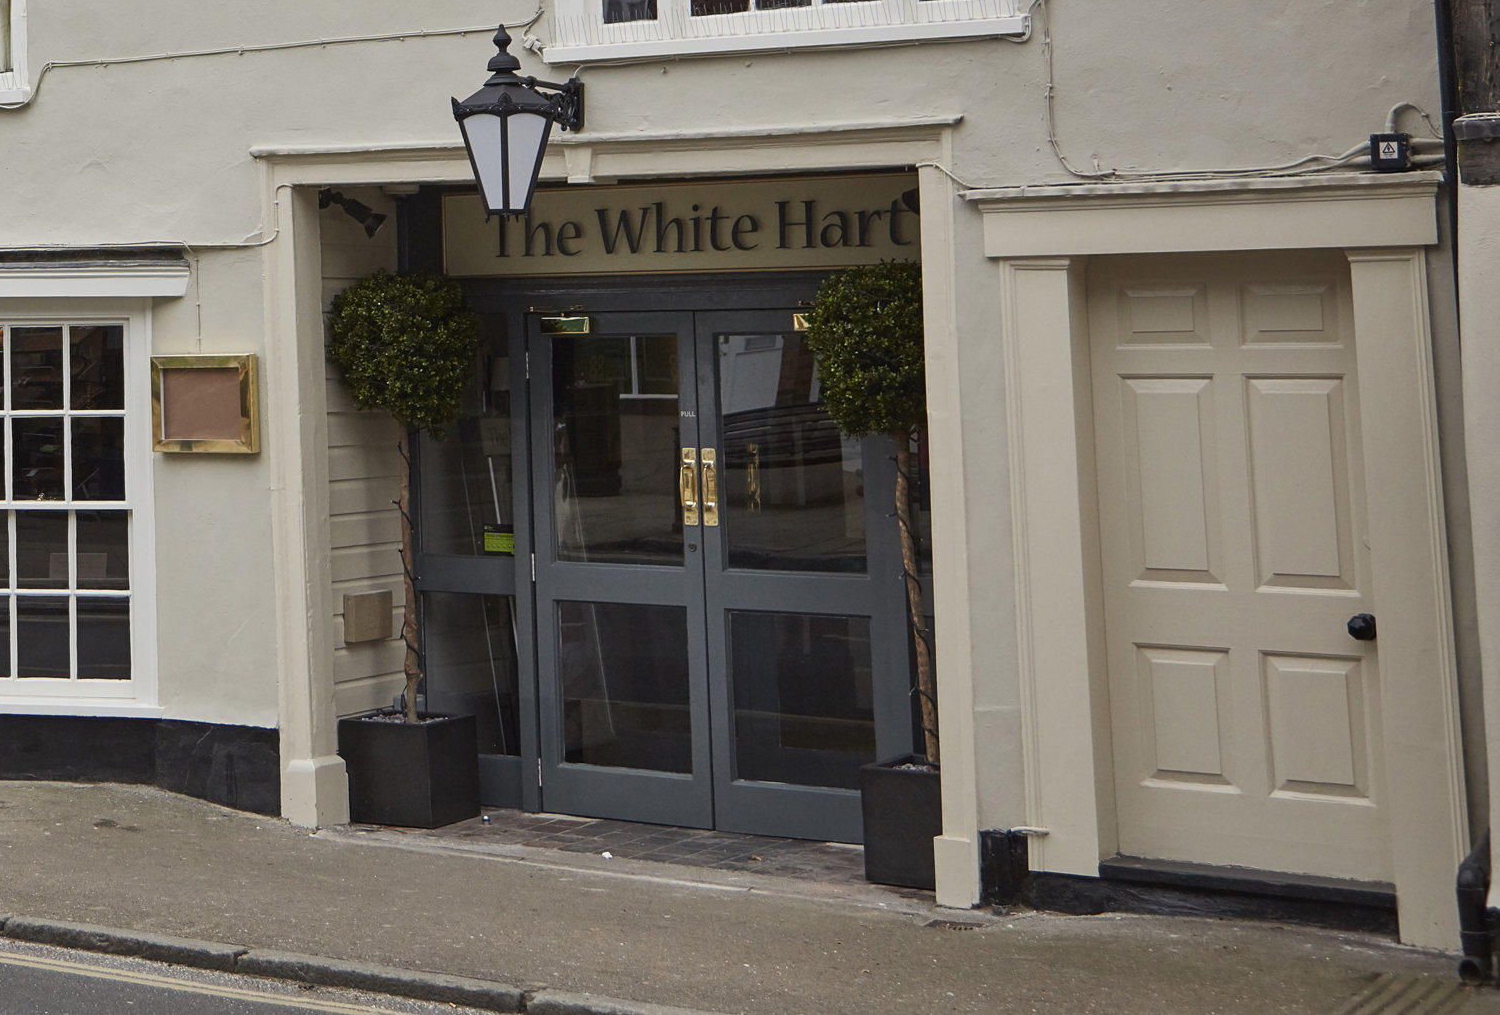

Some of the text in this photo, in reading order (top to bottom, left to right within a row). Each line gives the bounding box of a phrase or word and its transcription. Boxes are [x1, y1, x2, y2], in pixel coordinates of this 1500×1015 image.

[594, 201, 759, 255] White
[773, 199, 913, 250] Hart
[680, 410, 696, 418] PULL
